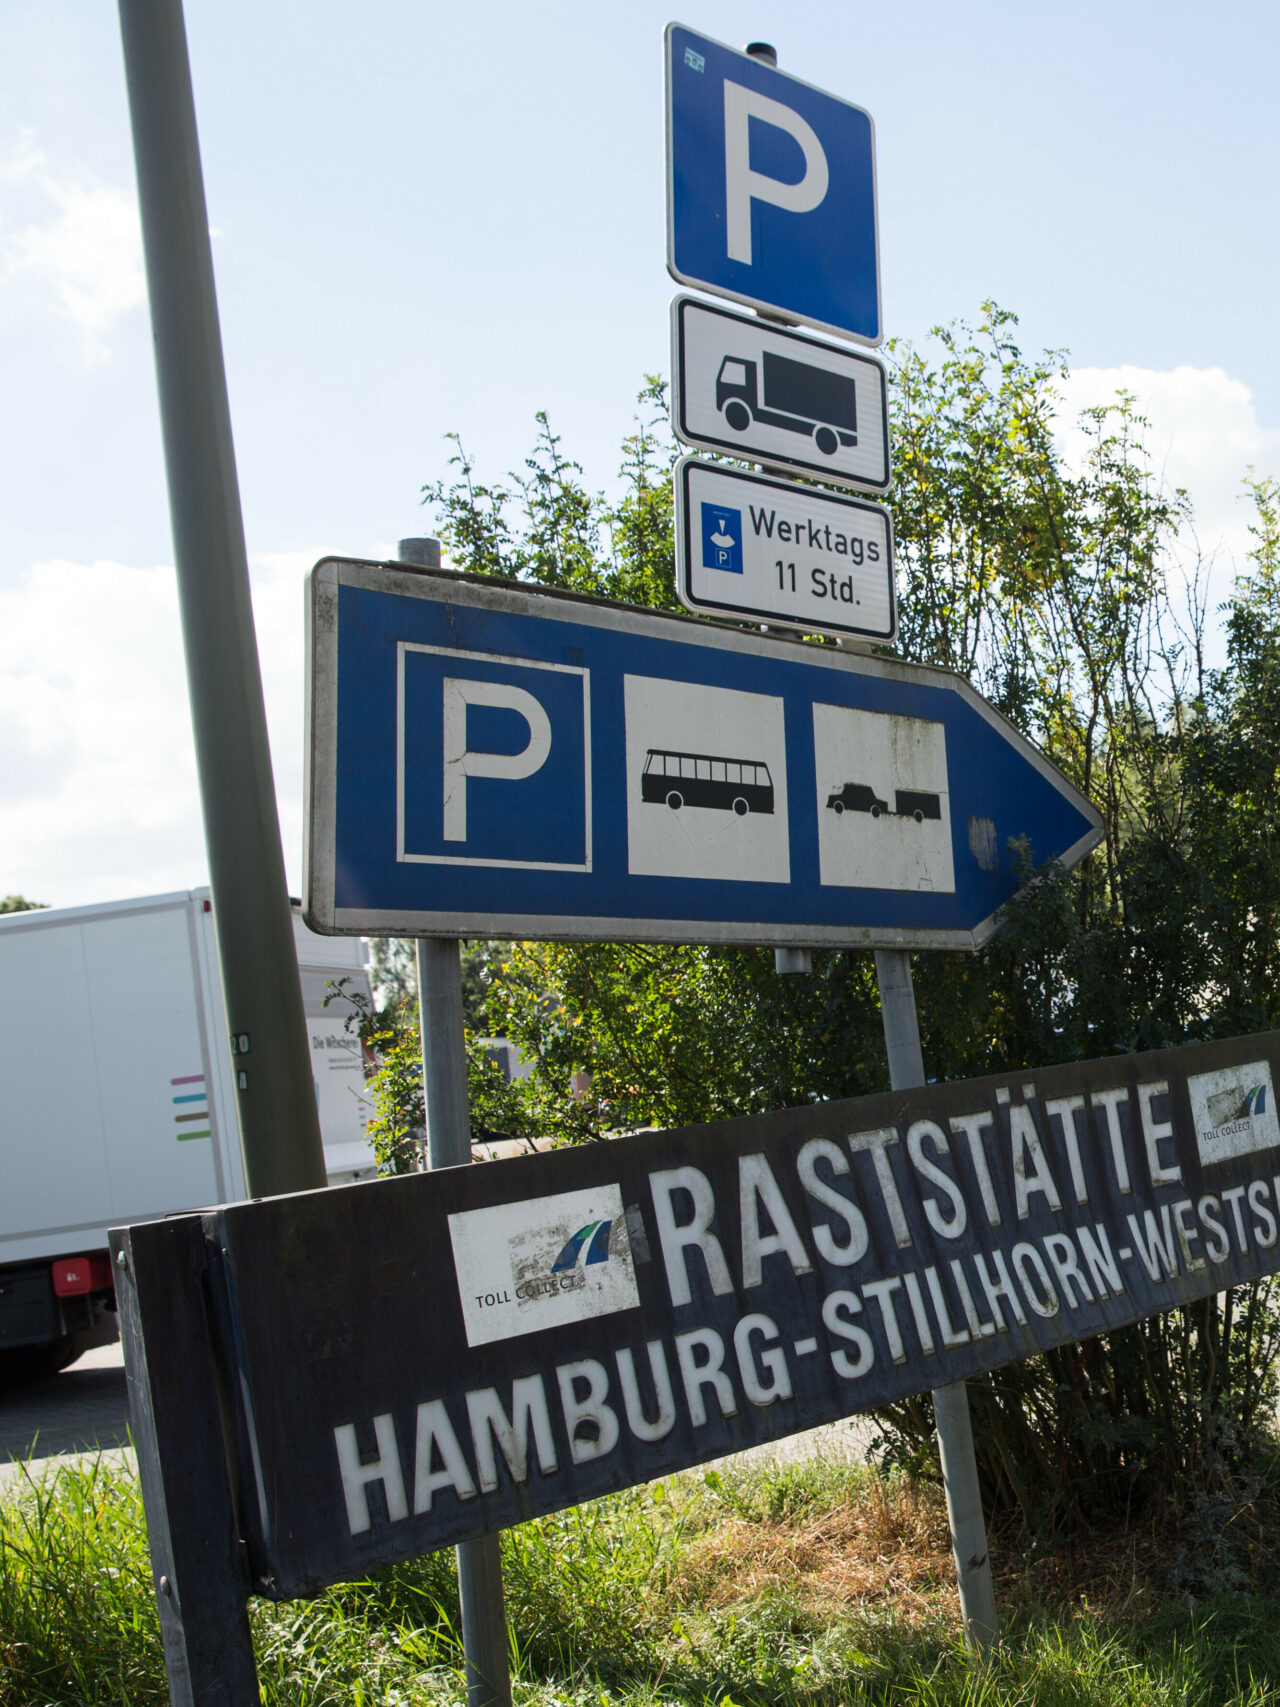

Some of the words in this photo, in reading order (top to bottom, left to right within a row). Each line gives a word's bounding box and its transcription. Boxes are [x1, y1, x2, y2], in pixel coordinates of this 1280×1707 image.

[723, 78, 829, 266] P
[719, 550, 728, 565] P
[749, 504, 880, 566] Werktags
[775, 560, 796, 592] 11
[811, 567, 860, 605] Std.
[443, 676, 552, 842] P
[1203, 1131, 1220, 1141] TOLL
[1221, 1121, 1250, 1136] COLLECT
[649, 1082, 1182, 1308] RASTSTÄTTE
[475, 1289, 511, 1309] TOLL
[515, 1275, 576, 1300] COLLECT
